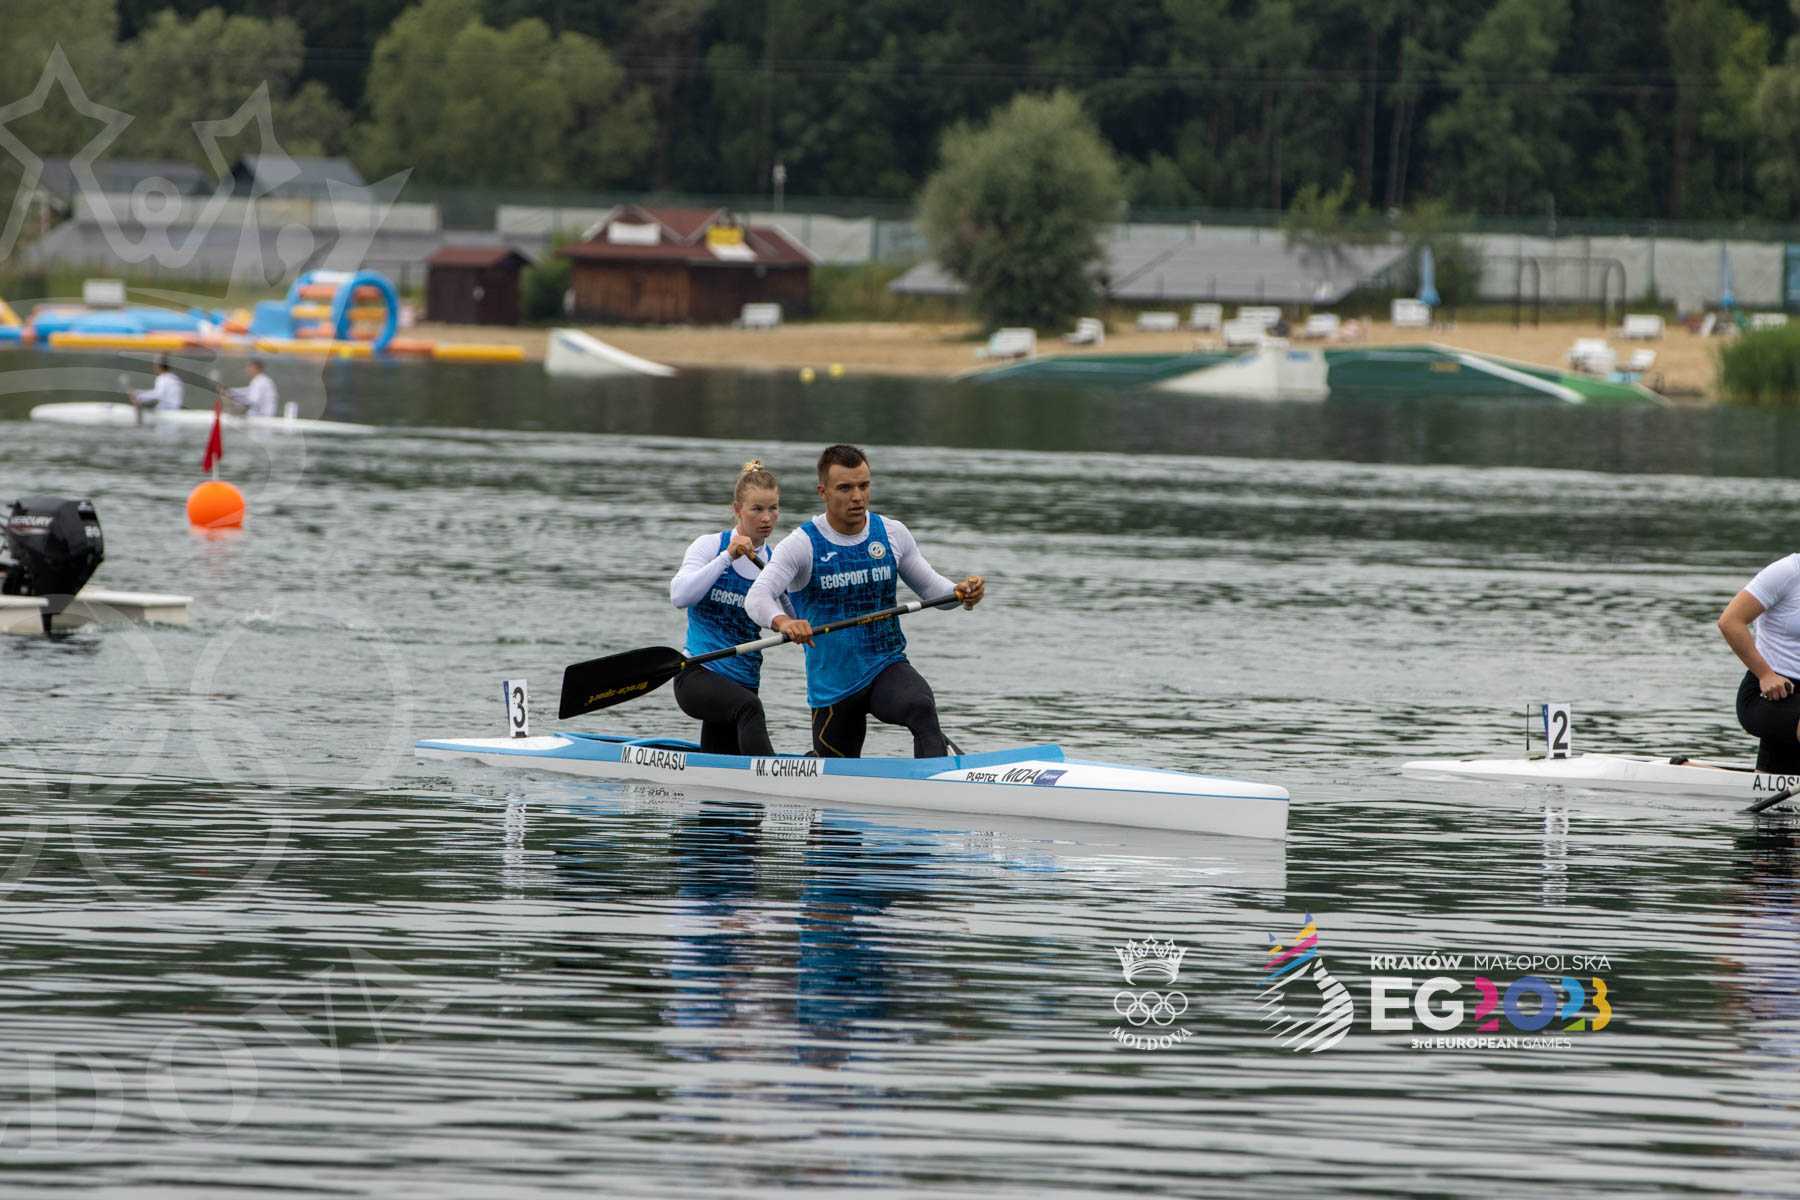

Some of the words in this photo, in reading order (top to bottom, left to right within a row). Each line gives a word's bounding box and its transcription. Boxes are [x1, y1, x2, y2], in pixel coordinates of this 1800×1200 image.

[820, 569, 868, 590] ECOSPORT
[871, 566, 892, 582] GYM
[512, 686, 526, 729] 3
[1552, 710, 1569, 750] 2
[621, 747, 632, 764] M.
[636, 748, 686, 771] OLARASU
[756, 759, 769, 777] M.
[772, 759, 818, 777] CHIHAIA
